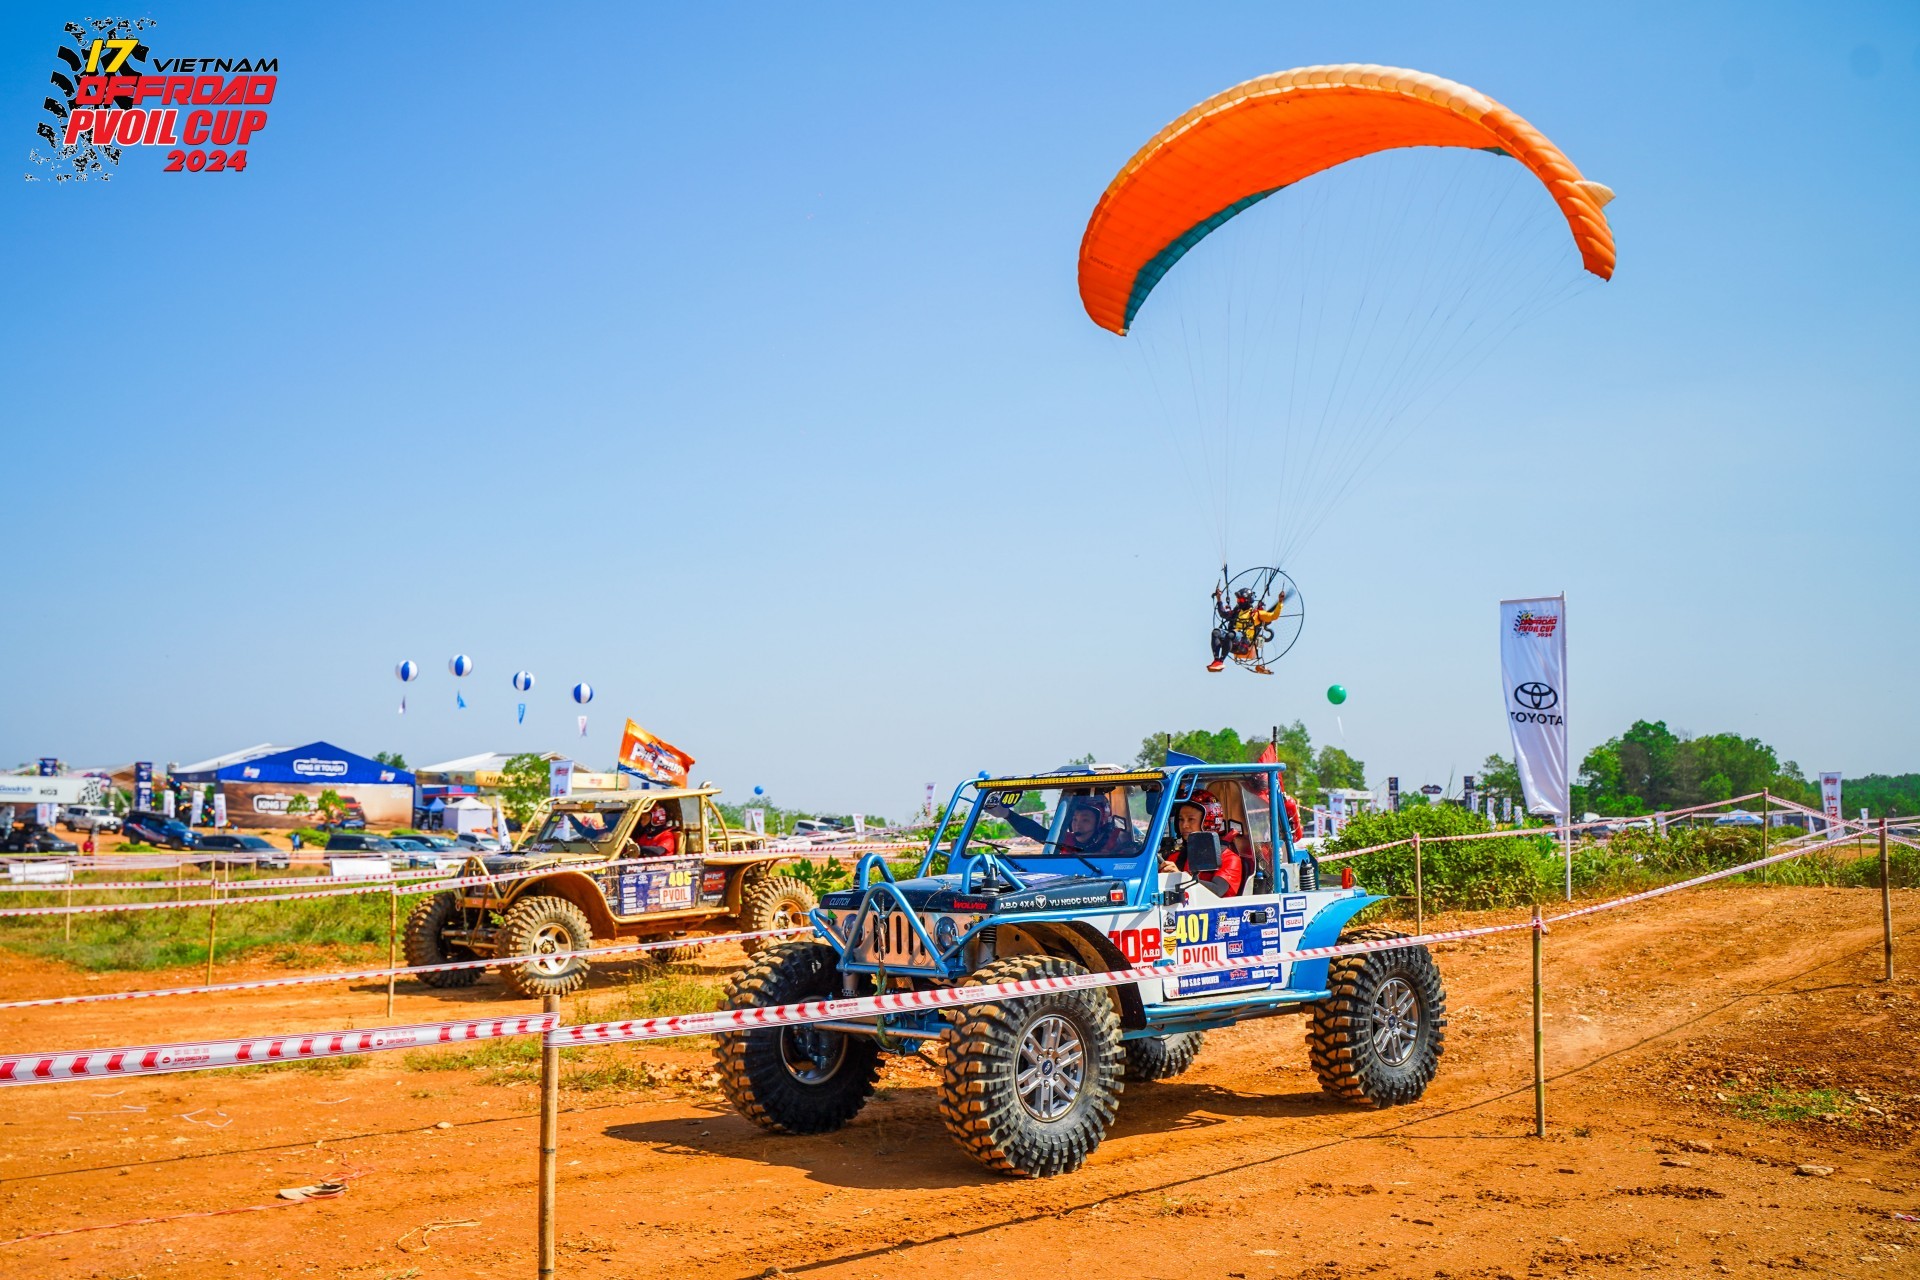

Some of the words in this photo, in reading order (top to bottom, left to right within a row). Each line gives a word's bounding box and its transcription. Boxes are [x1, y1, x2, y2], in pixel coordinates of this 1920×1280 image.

[1518, 625, 1539, 633] PVOIL
[1540, 625, 1556, 633] CUP
[1001, 792, 1021, 805] 407
[662, 888, 688, 902] PVOIL
[829, 897, 851, 906] CLUTCH
[953, 899, 988, 910] WOLVER
[1285, 918, 1302, 926] ISUZU
[1175, 912, 1209, 944] 407
